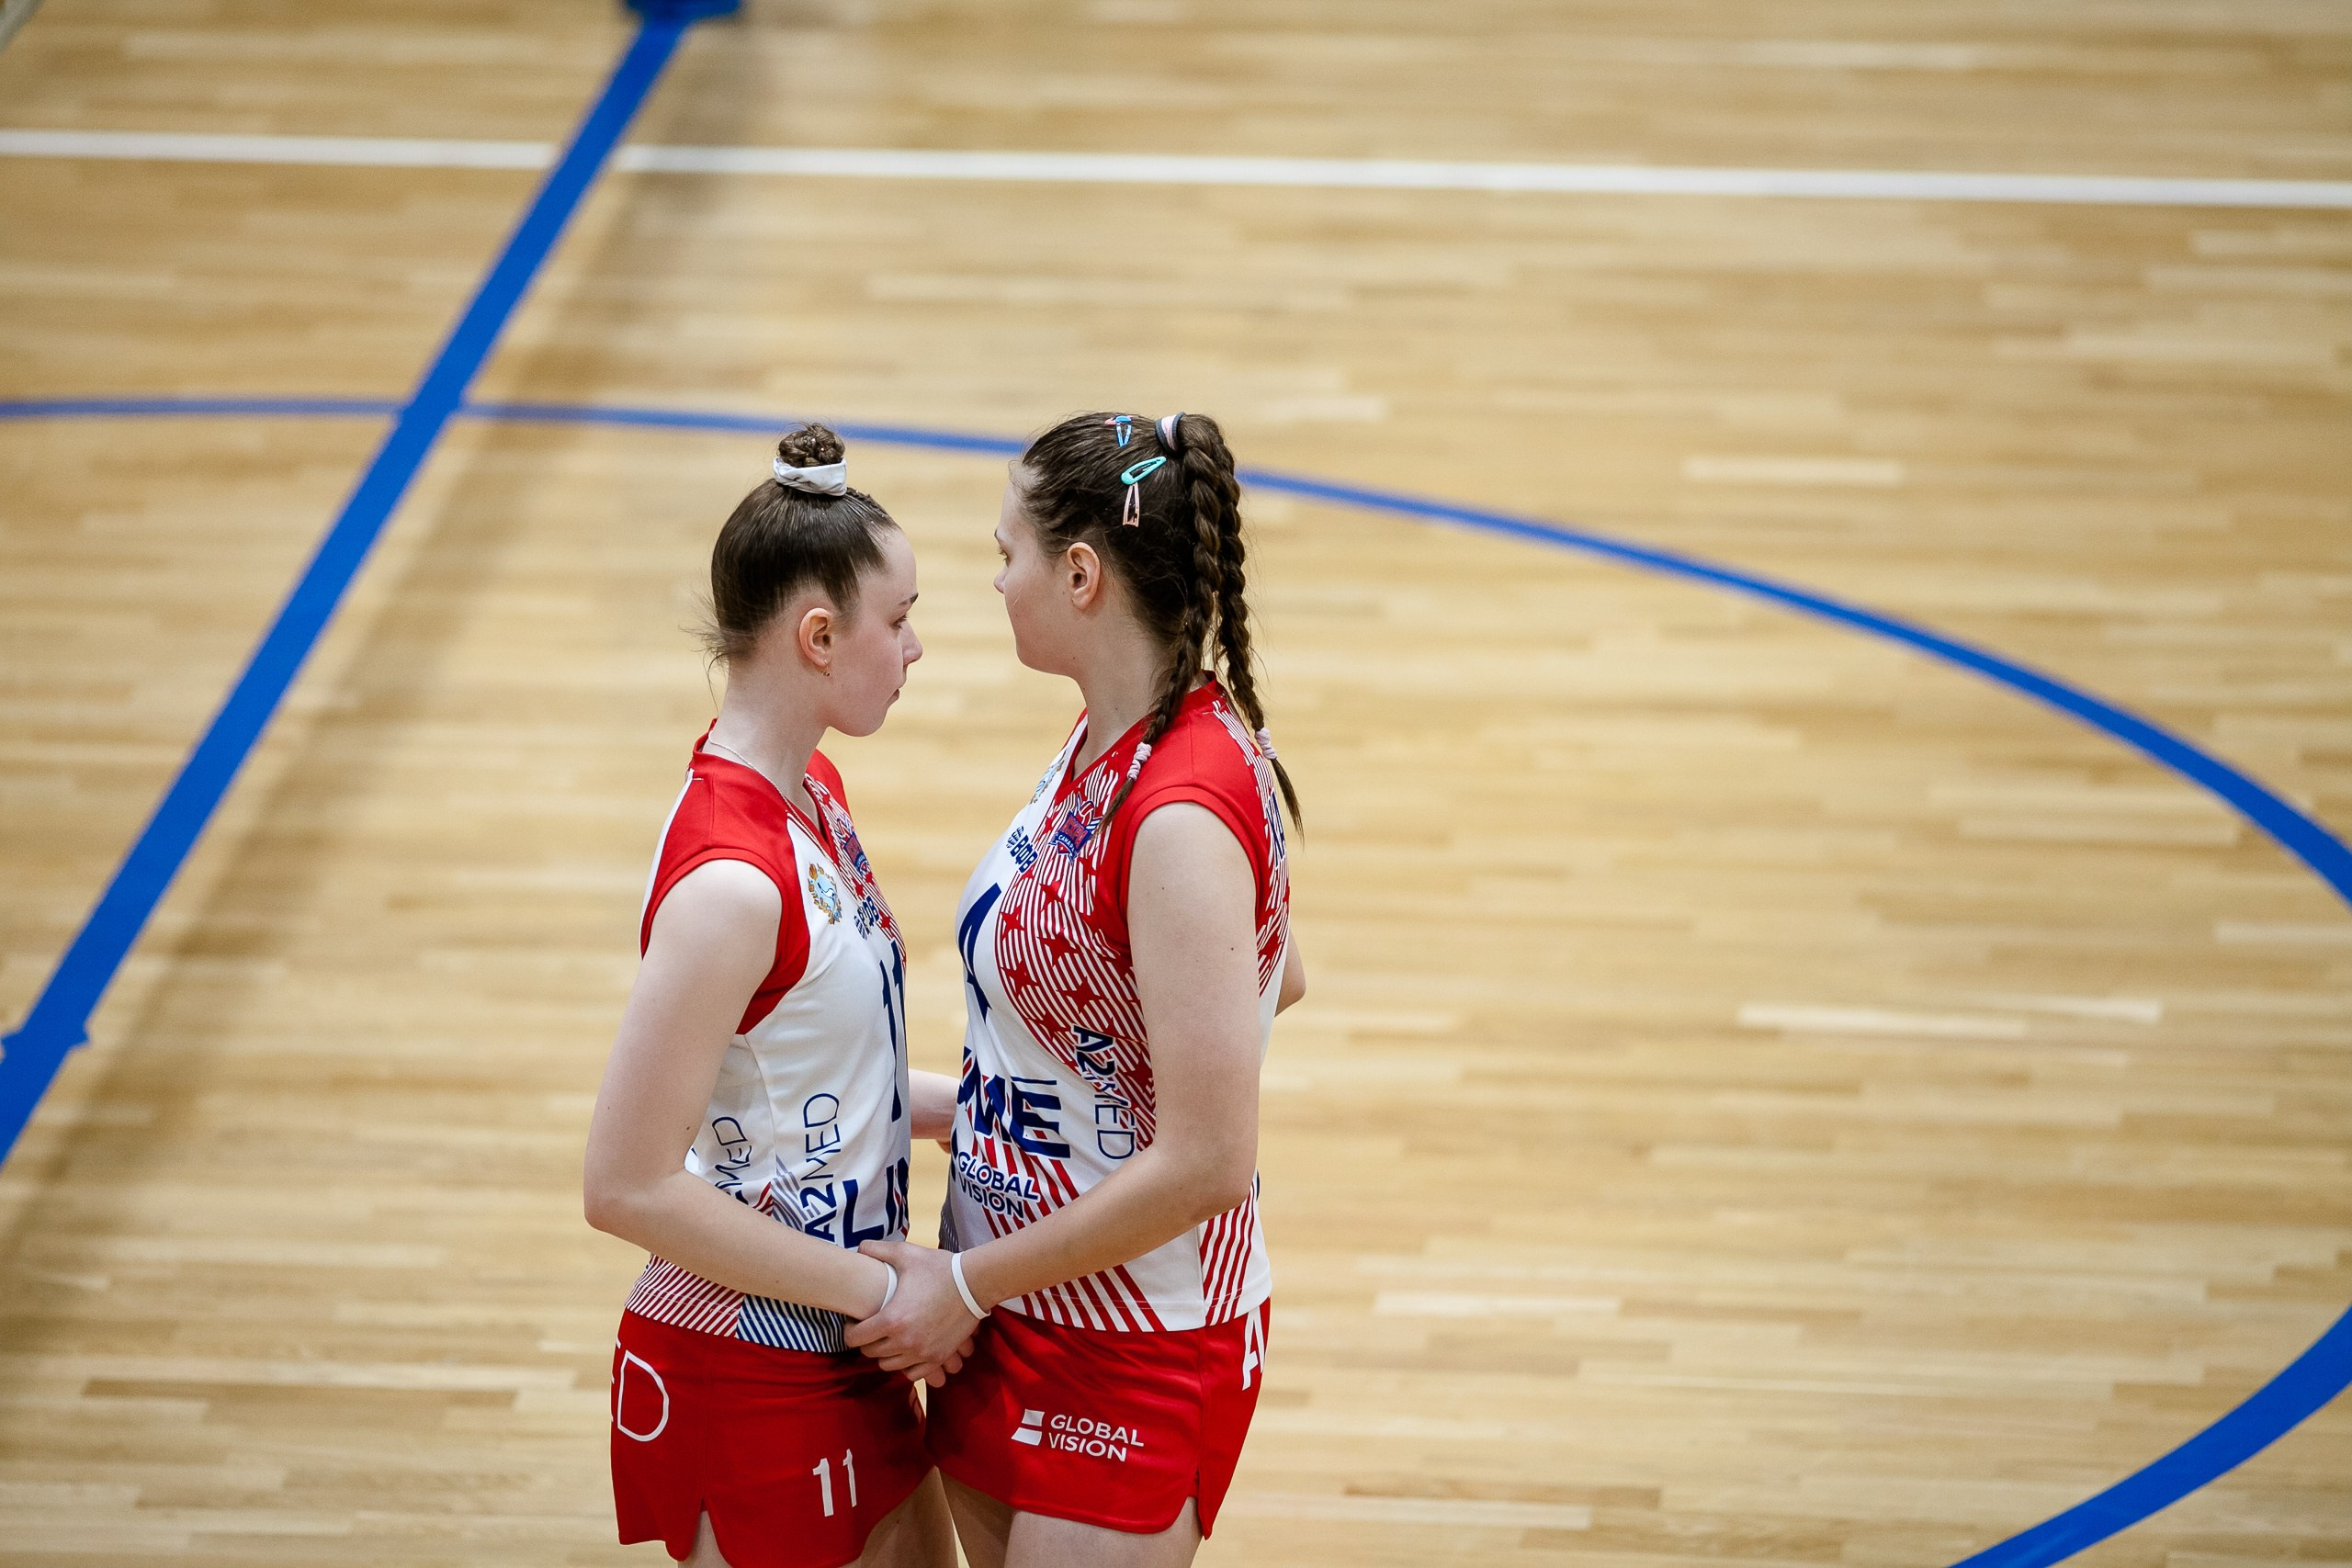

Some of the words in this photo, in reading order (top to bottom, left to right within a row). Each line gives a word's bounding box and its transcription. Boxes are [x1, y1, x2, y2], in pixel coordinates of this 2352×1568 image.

[1072, 1024, 1136, 1159] A2MED
[712, 1116, 752, 1204] MED
[800, 1093, 842, 1243] A2MED
[958, 1152, 1040, 1201] GLOBAL
[960, 1179, 1024, 1219] VISION
[1048, 1432, 1127, 1462] VISION
[1050, 1414, 1145, 1447] GLOBAL
[812, 1449, 857, 1517] 11
